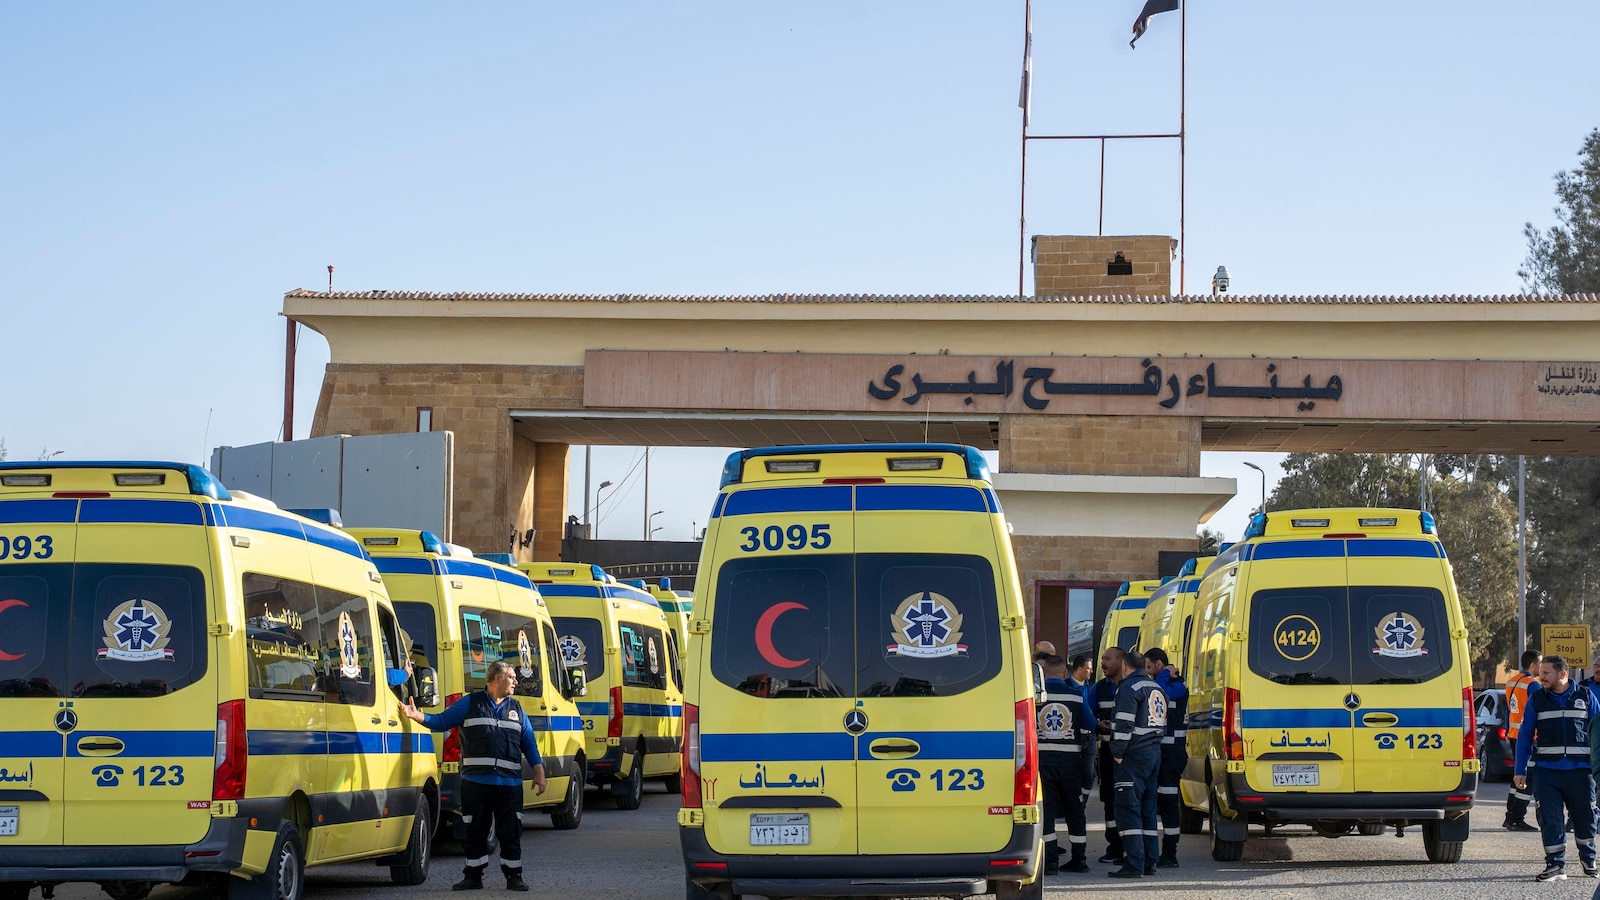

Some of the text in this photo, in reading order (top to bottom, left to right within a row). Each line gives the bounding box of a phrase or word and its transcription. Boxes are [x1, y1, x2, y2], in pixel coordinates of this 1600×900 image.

[1022, 358, 1180, 409] رفح
[1545, 366, 1597, 383] وزارة النقل
[1186, 363, 1342, 411] ميناء
[740, 524, 831, 552] 3095
[1278, 629, 1317, 646] 4124
[1575, 630, 1584, 639] قف
[1556, 645, 1575, 653] Stop
[1270, 729, 1331, 751] إسعاف
[1405, 733, 1443, 749] 123
[132, 765, 184, 786] 123
[739, 763, 825, 794] إسعاف
[930, 768, 985, 791] 123
[755, 827, 775, 838] ٧٣٦
